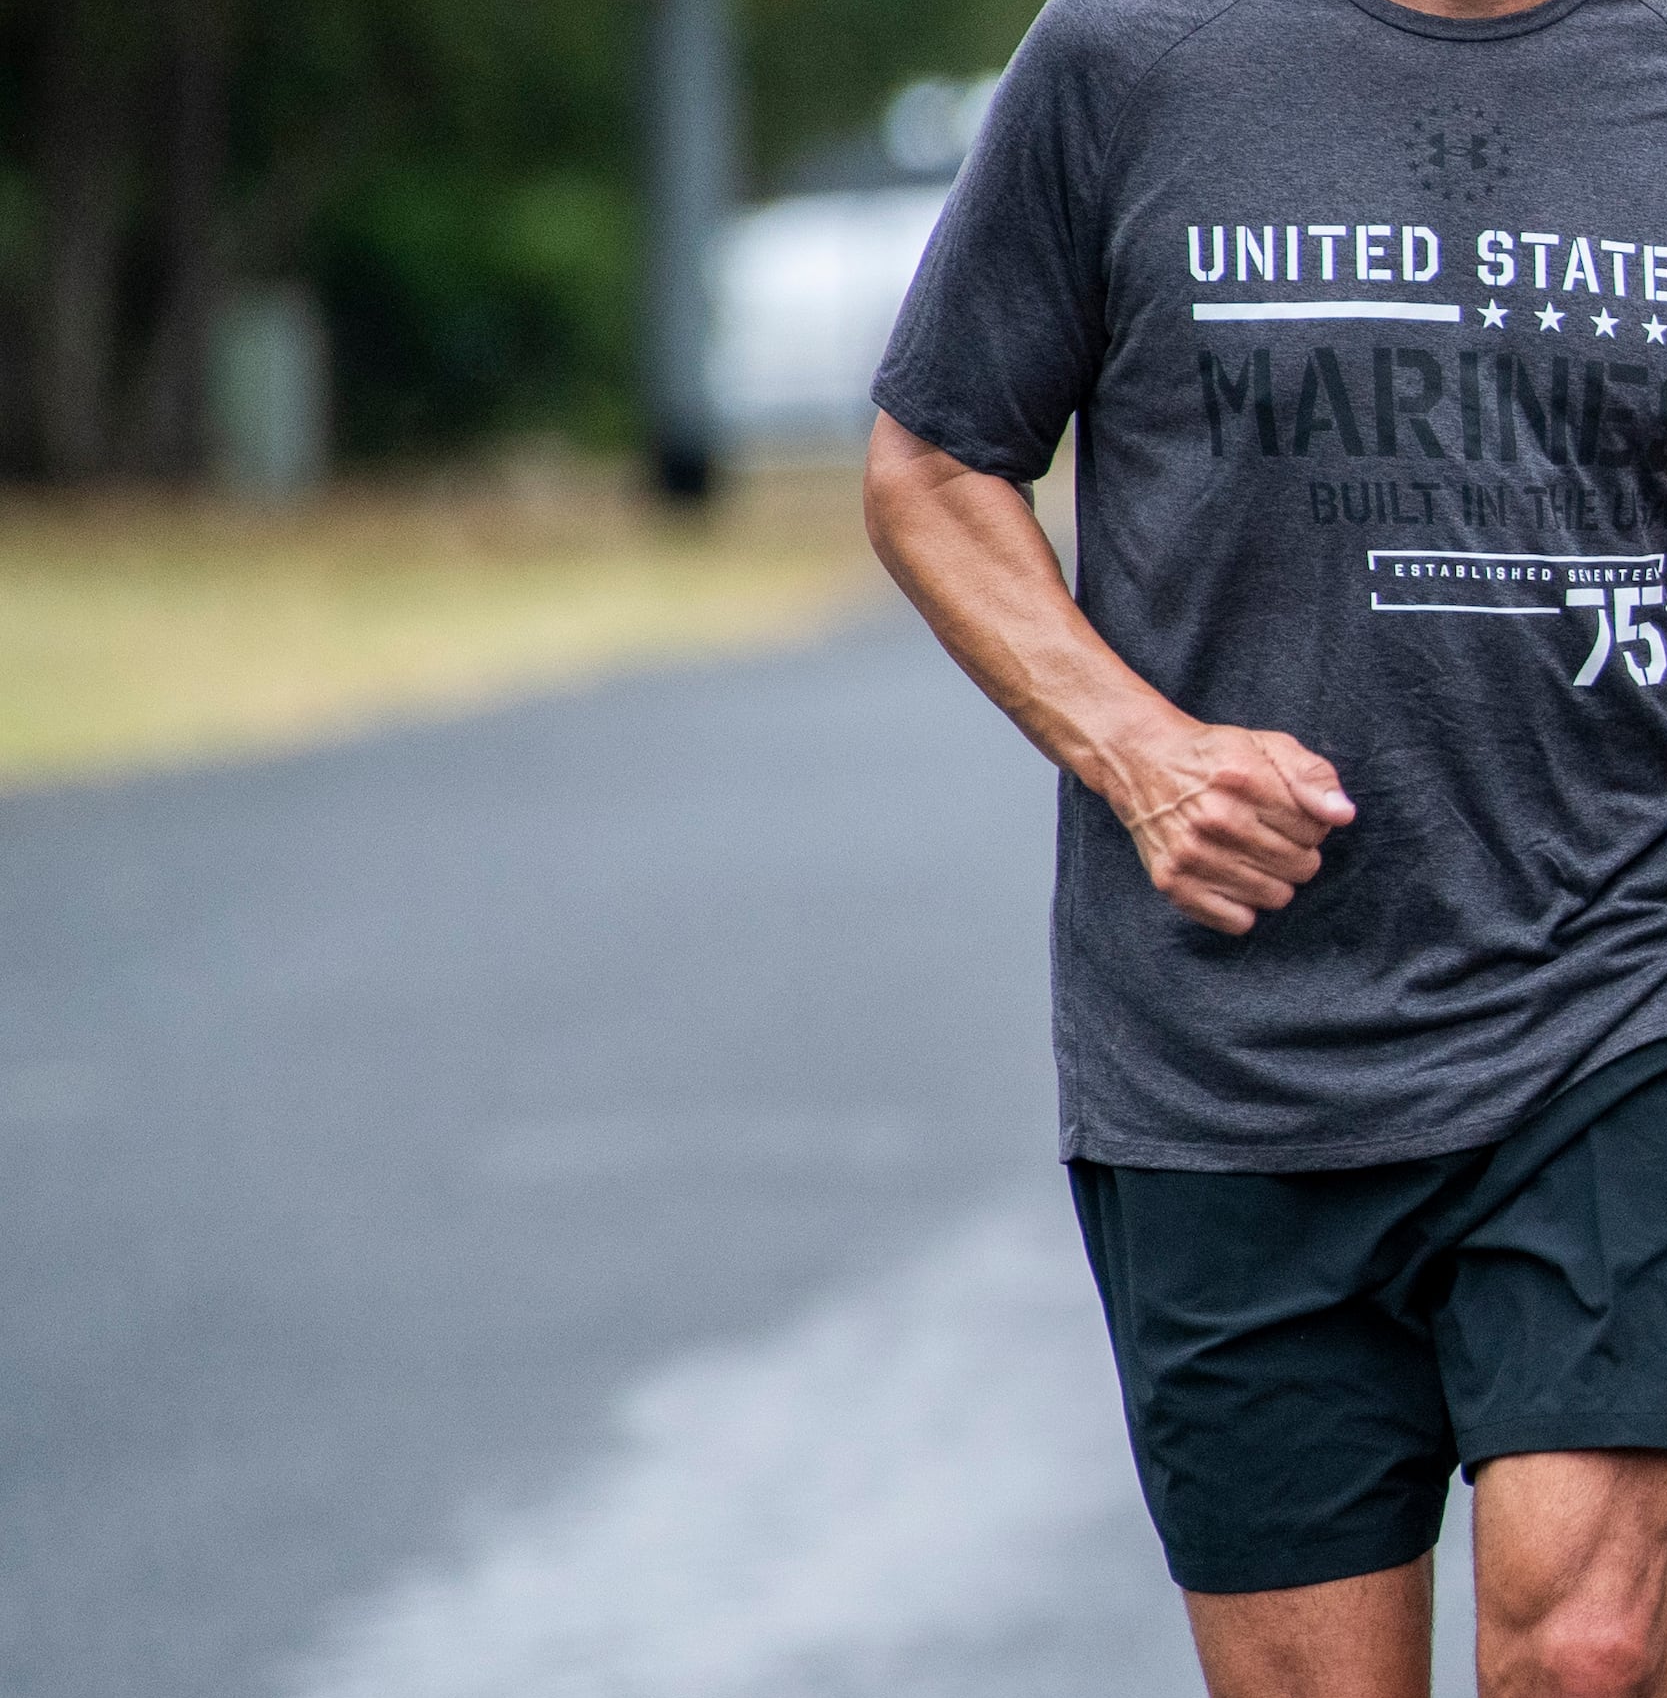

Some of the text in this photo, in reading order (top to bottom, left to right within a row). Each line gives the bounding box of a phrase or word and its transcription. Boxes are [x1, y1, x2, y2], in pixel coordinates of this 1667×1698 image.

[1187, 225, 1440, 285] UNITED
[1309, 481, 1441, 526] BUILT
[1462, 483, 1506, 527] IN
[1522, 485, 1600, 531] THE
[1394, 562, 1552, 582] ESTABLISHED
[1565, 585, 1667, 687] 75
